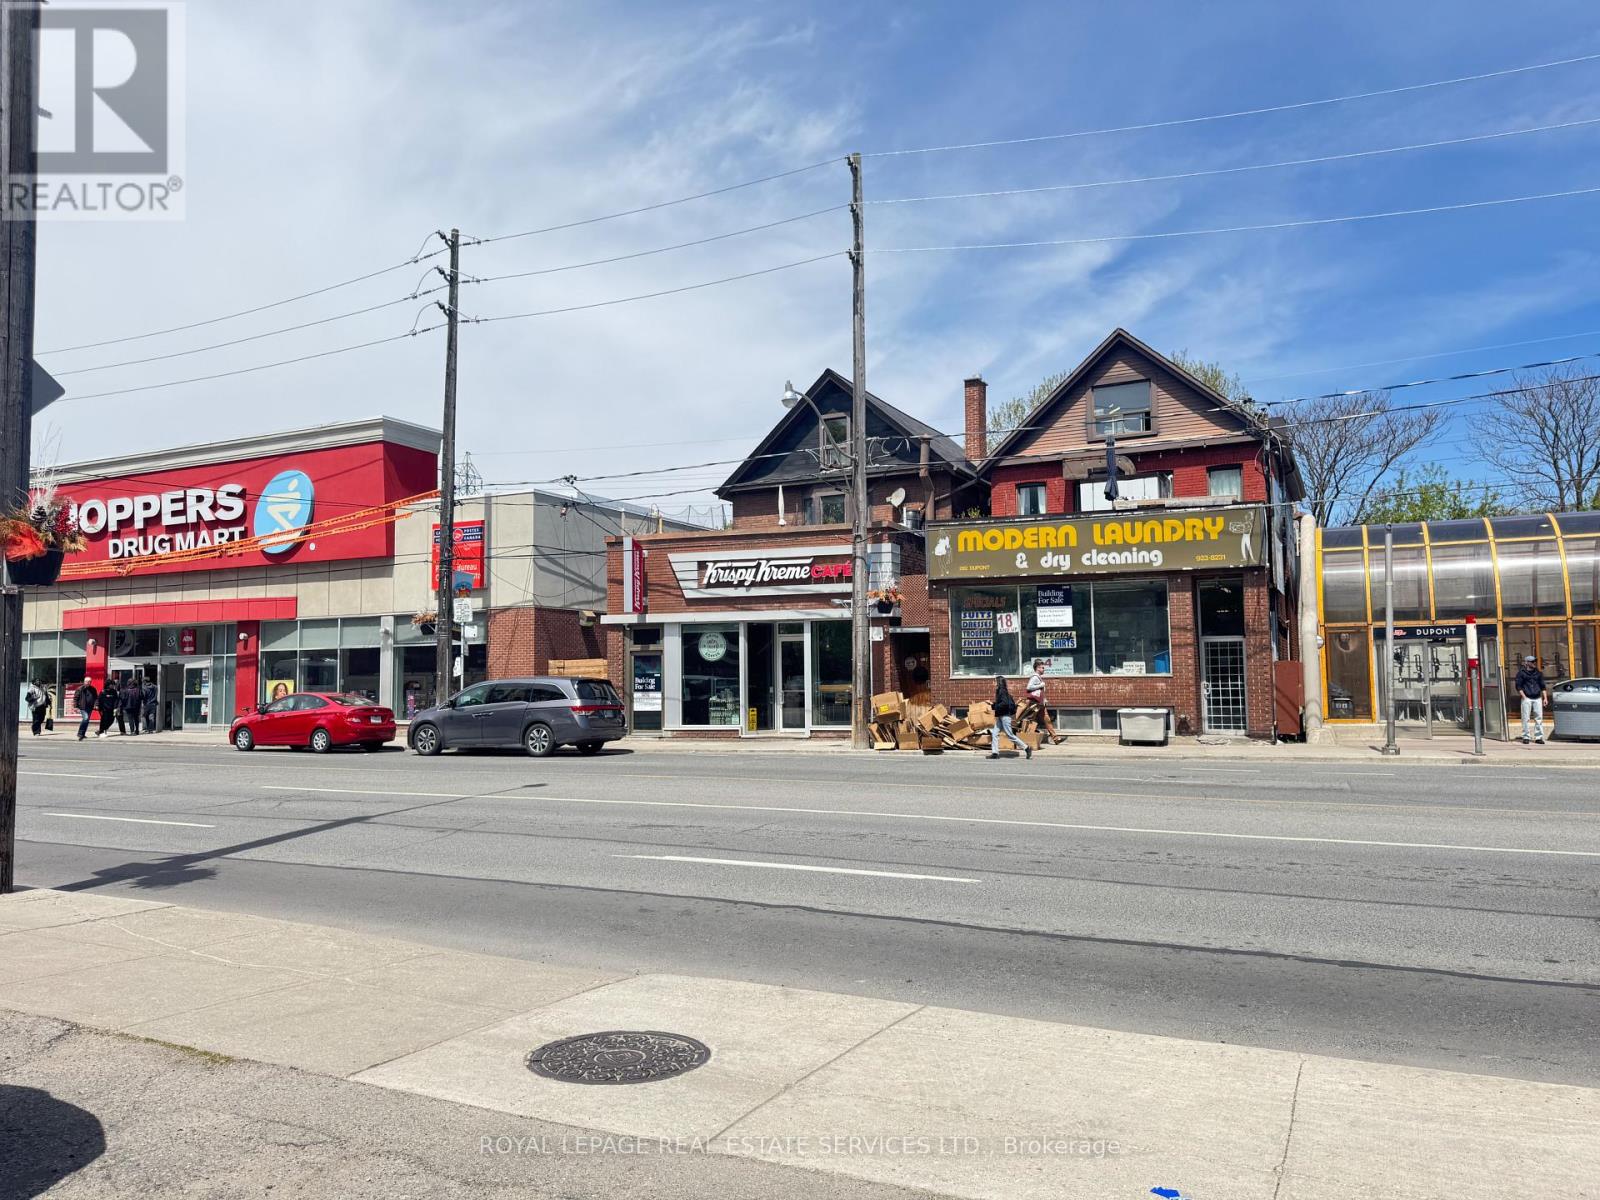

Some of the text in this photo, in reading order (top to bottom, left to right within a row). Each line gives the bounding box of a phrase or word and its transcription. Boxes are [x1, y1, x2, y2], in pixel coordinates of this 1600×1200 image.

[957, 516, 1225, 552] MODERN LAUNDRY
[108, 527, 245, 559] DRUG MART
[1015, 547, 1164, 571] & dry cleaning
[703, 560, 758, 586] Krispy
[757, 557, 814, 583] Kreme
[1037, 589, 1064, 598] Building
[962, 611, 991, 619] SUITS
[1416, 627, 1456, 636] DUPONT
[1050, 640, 1075, 648] SHIRTS
